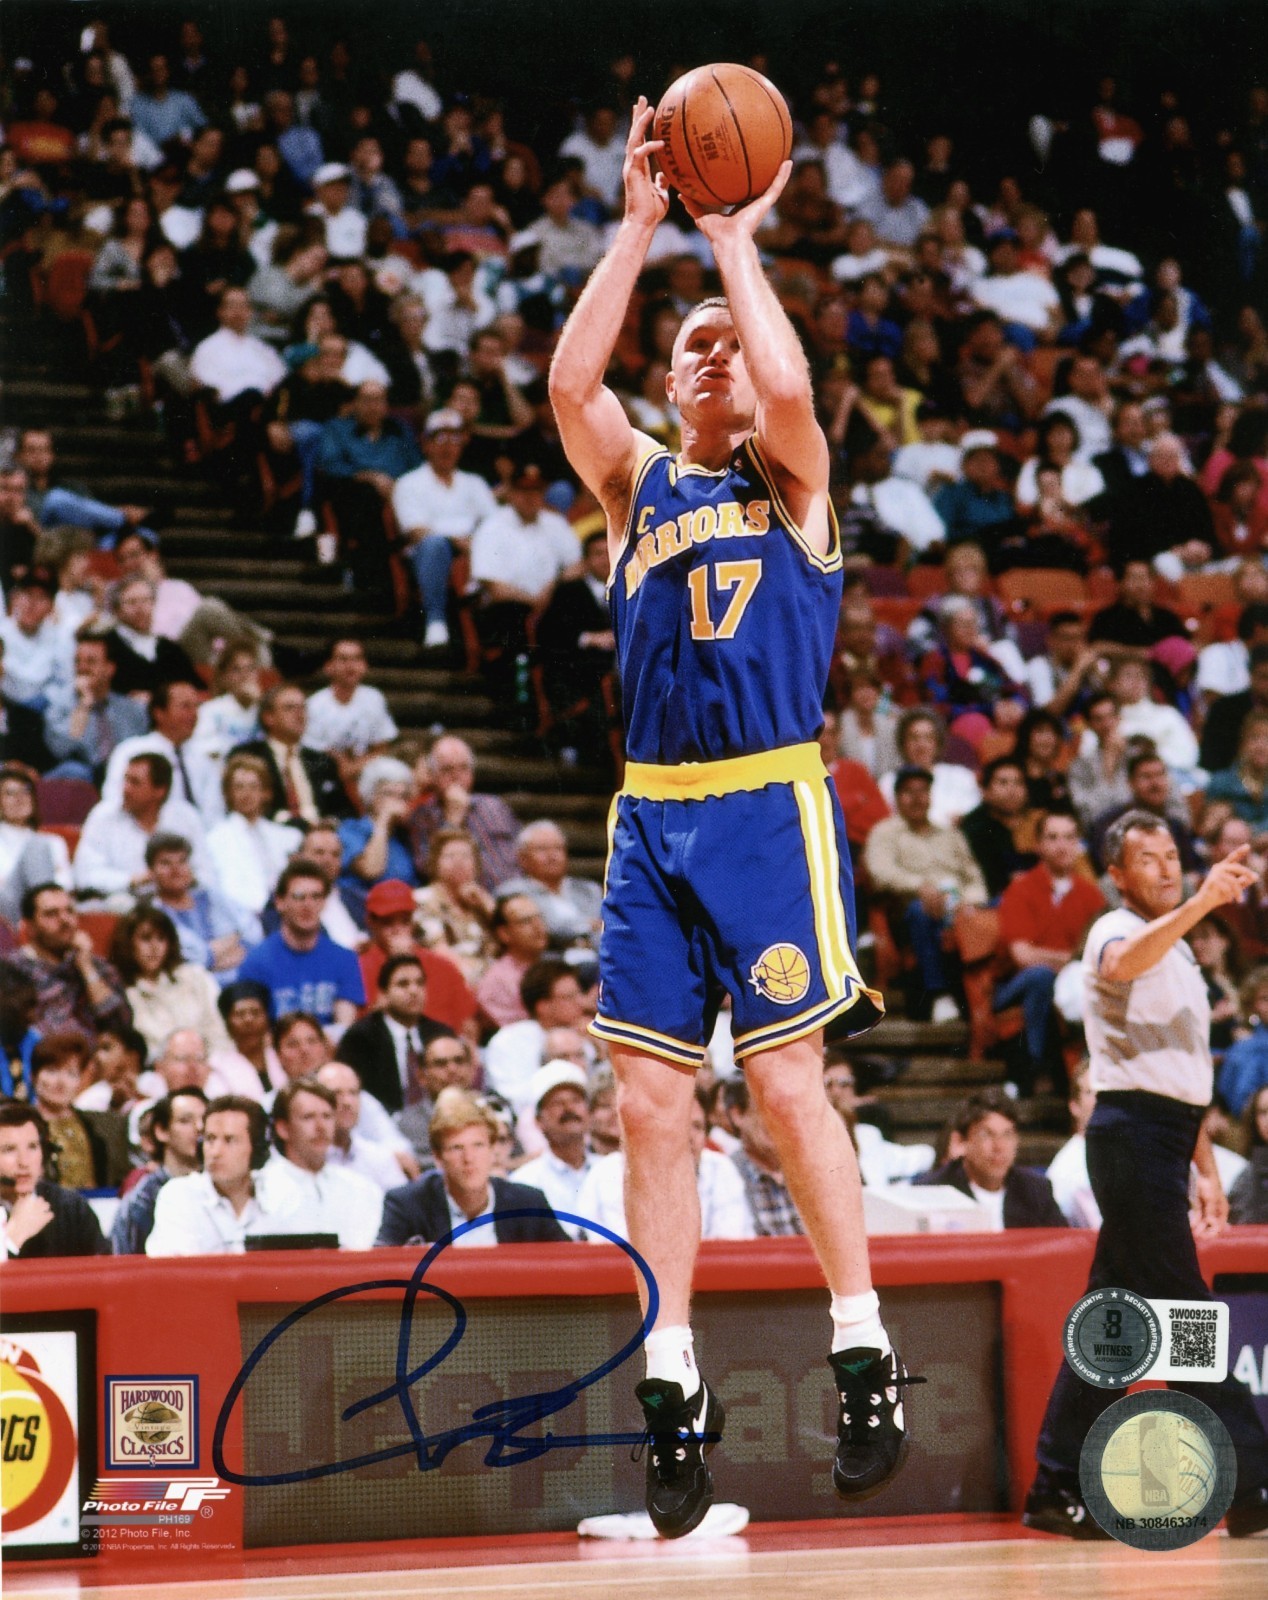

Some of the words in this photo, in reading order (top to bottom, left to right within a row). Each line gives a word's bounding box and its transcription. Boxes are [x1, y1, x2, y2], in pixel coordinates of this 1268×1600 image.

[701, 132, 720, 160] NBA
[636, 505, 655, 535] C
[687, 558, 762, 640] 17
